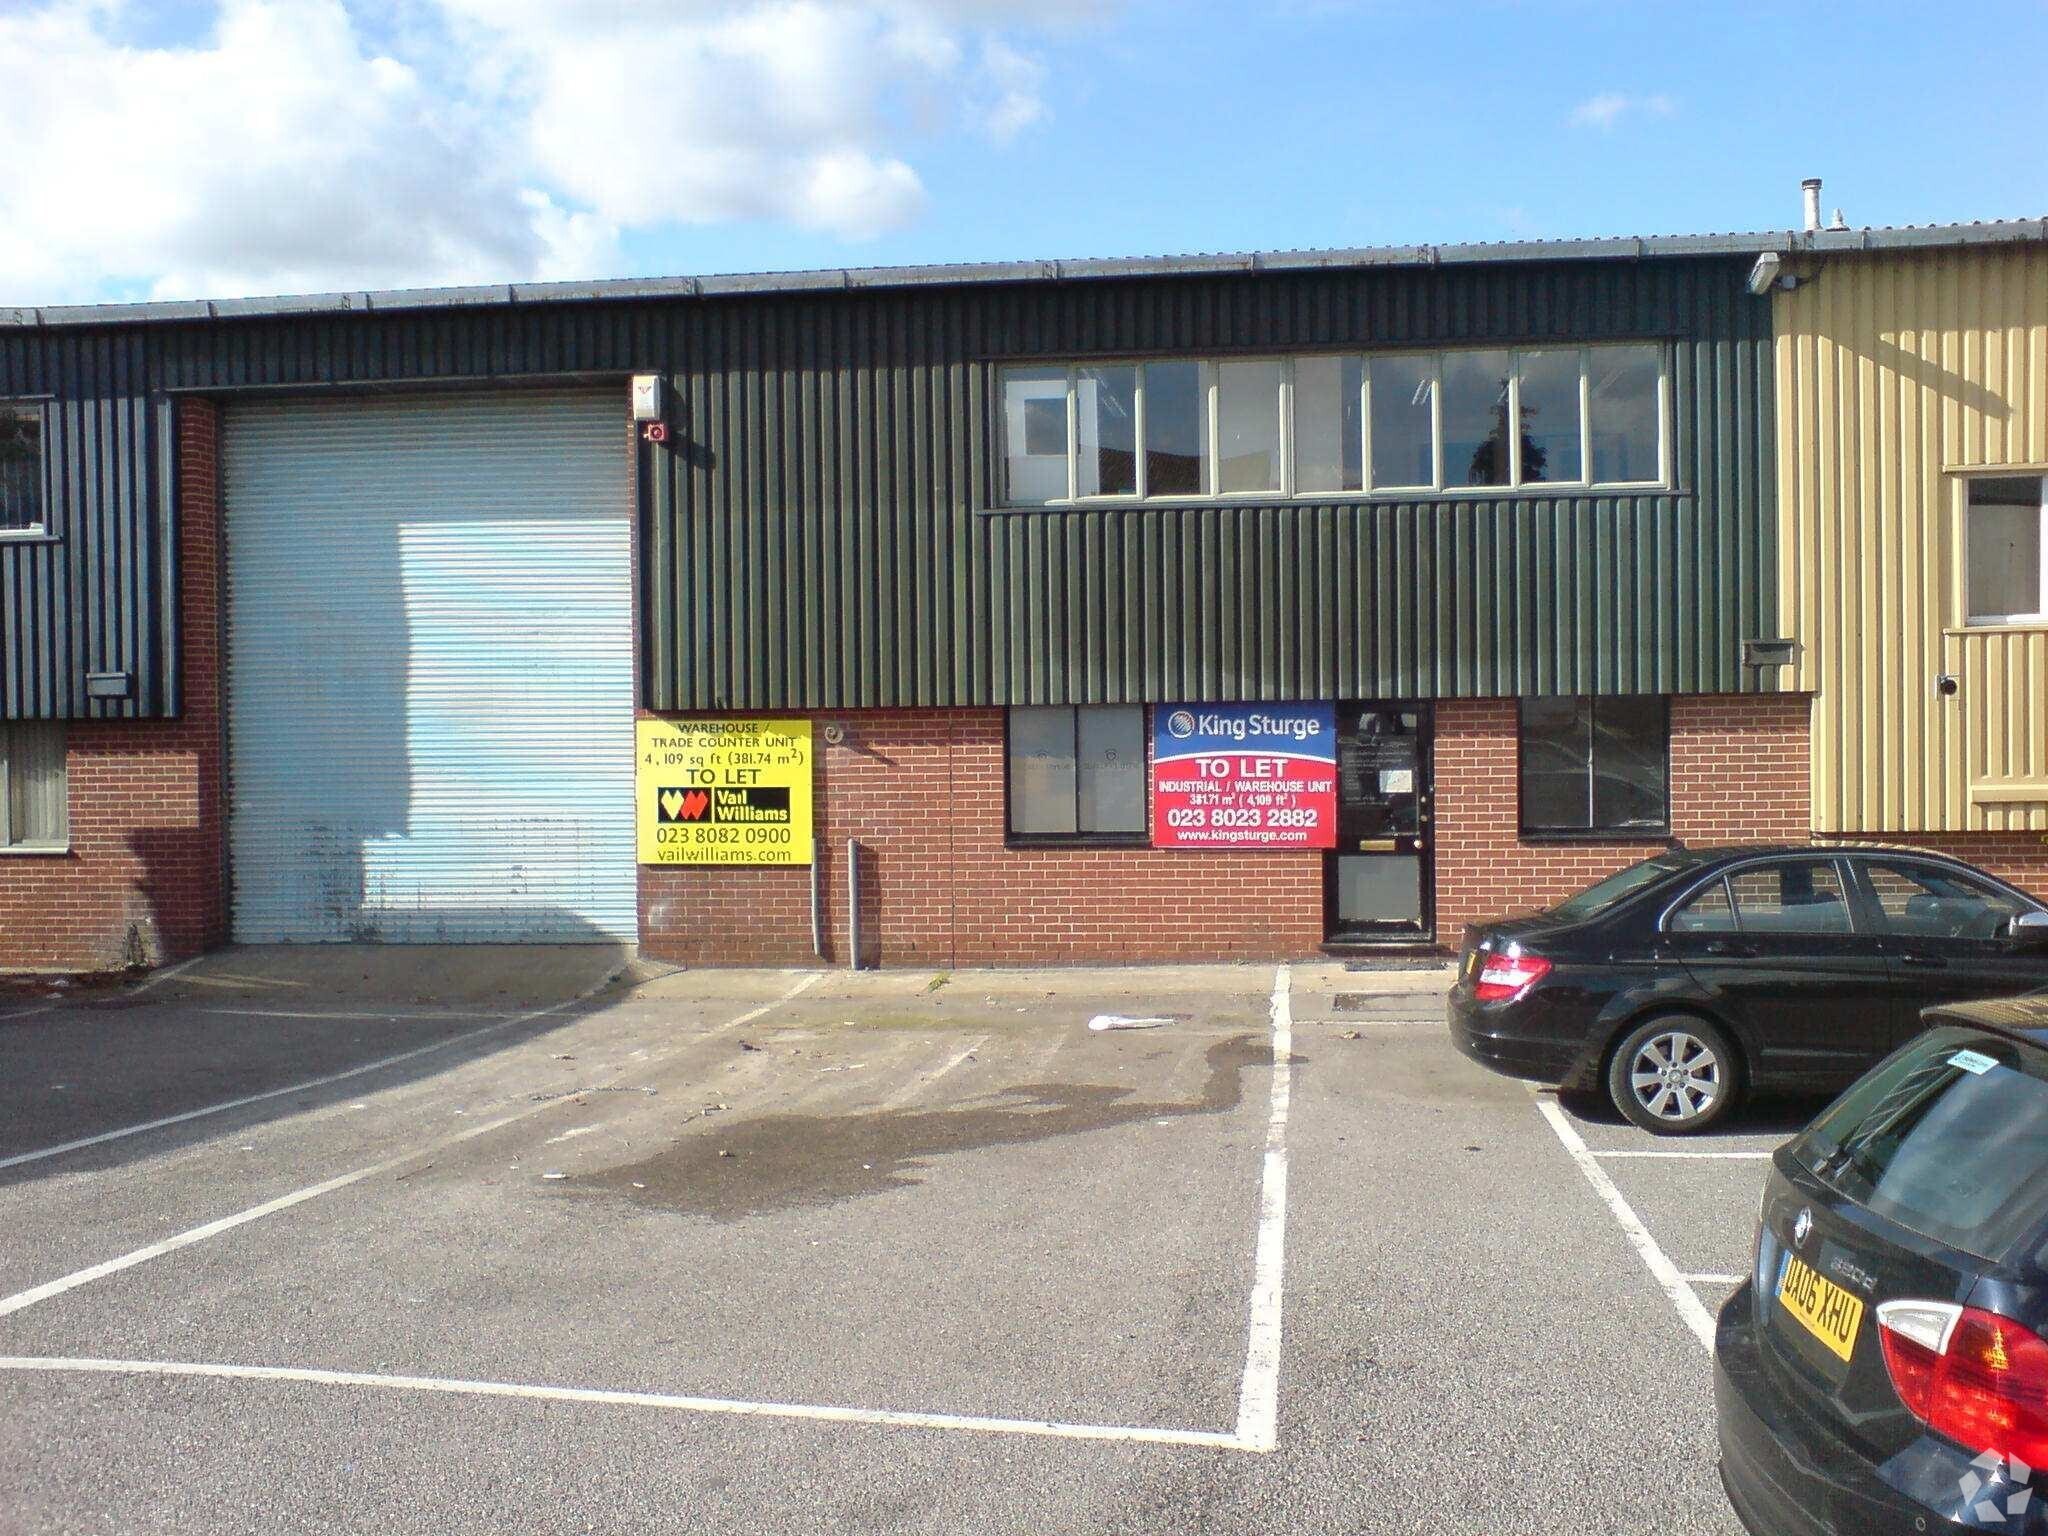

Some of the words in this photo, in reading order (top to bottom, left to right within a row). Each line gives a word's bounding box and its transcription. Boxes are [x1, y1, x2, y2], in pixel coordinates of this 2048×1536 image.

[678, 723, 759, 734] WAREHOUSE
[1198, 714, 1246, 740] King
[1249, 714, 1320, 740] Sturge
[652, 737, 694, 748] TRADE
[698, 737, 760, 748] COUNTER
[765, 736, 797, 748] UNIT
[689, 755, 704, 768] sq
[710, 752, 721, 765] ft
[1195, 758, 1230, 778] TO
[1240, 758, 1289, 778] LET
[686, 768, 716, 785] TO
[725, 768, 762, 785] LET
[1158, 780, 1222, 793] INDUSTRIAL
[1234, 780, 1304, 793] WAREHOUSE
[1308, 780, 1332, 793] UNIT
[716, 789, 747, 805] Vail
[716, 805, 788, 821] Williams
[1167, 808, 1206, 828] 023
[1210, 808, 1262, 828] 8023
[1266, 808, 1318, 828] 2882
[656, 827, 690, 844] 023
[695, 827, 740, 844] 8082
[745, 827, 791, 844] 0900
[1176, 829, 1308, 843] www.kingsturge.com
[657, 847, 791, 862] vailwilliams.com
[1817, 1281, 1857, 1344] XHU
